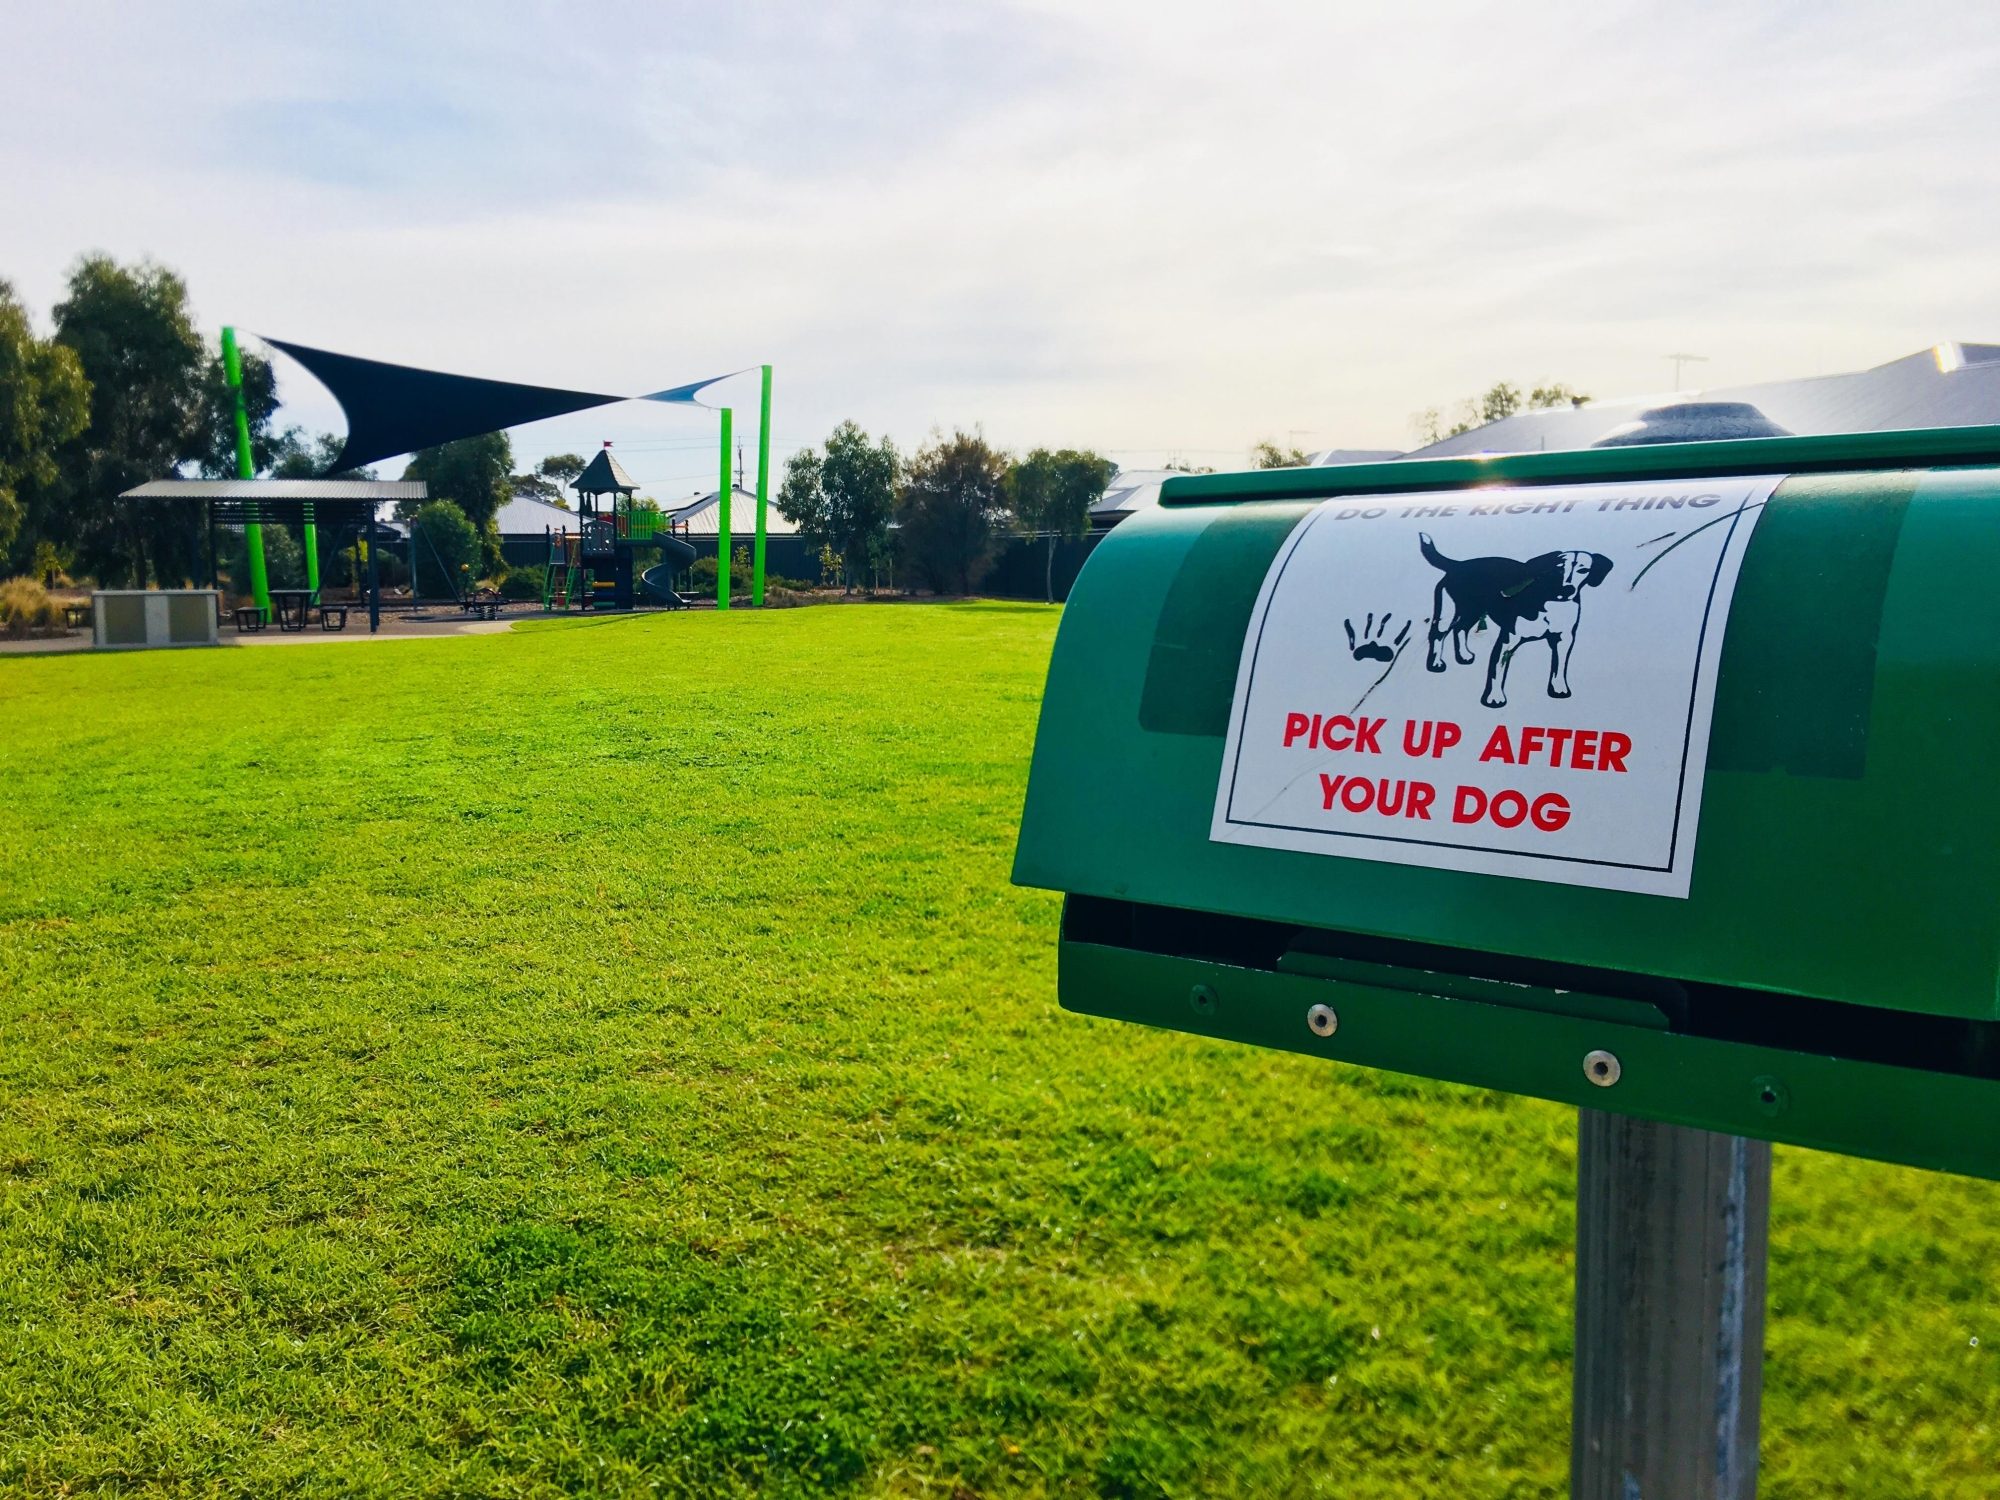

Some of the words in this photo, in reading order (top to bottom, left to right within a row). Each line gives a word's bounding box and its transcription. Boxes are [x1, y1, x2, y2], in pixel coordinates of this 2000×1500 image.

[1334, 507, 1385, 521] DO
[1400, 504, 1458, 519] THE
[1468, 499, 1585, 517] RIGHT
[1597, 493, 1721, 512] THING
[1283, 712, 1387, 754] PICK
[1403, 719, 1462, 758] UP
[1479, 725, 1632, 772] AFTER
[1318, 773, 1436, 820] YOUR
[1452, 785, 1571, 832] DOG
